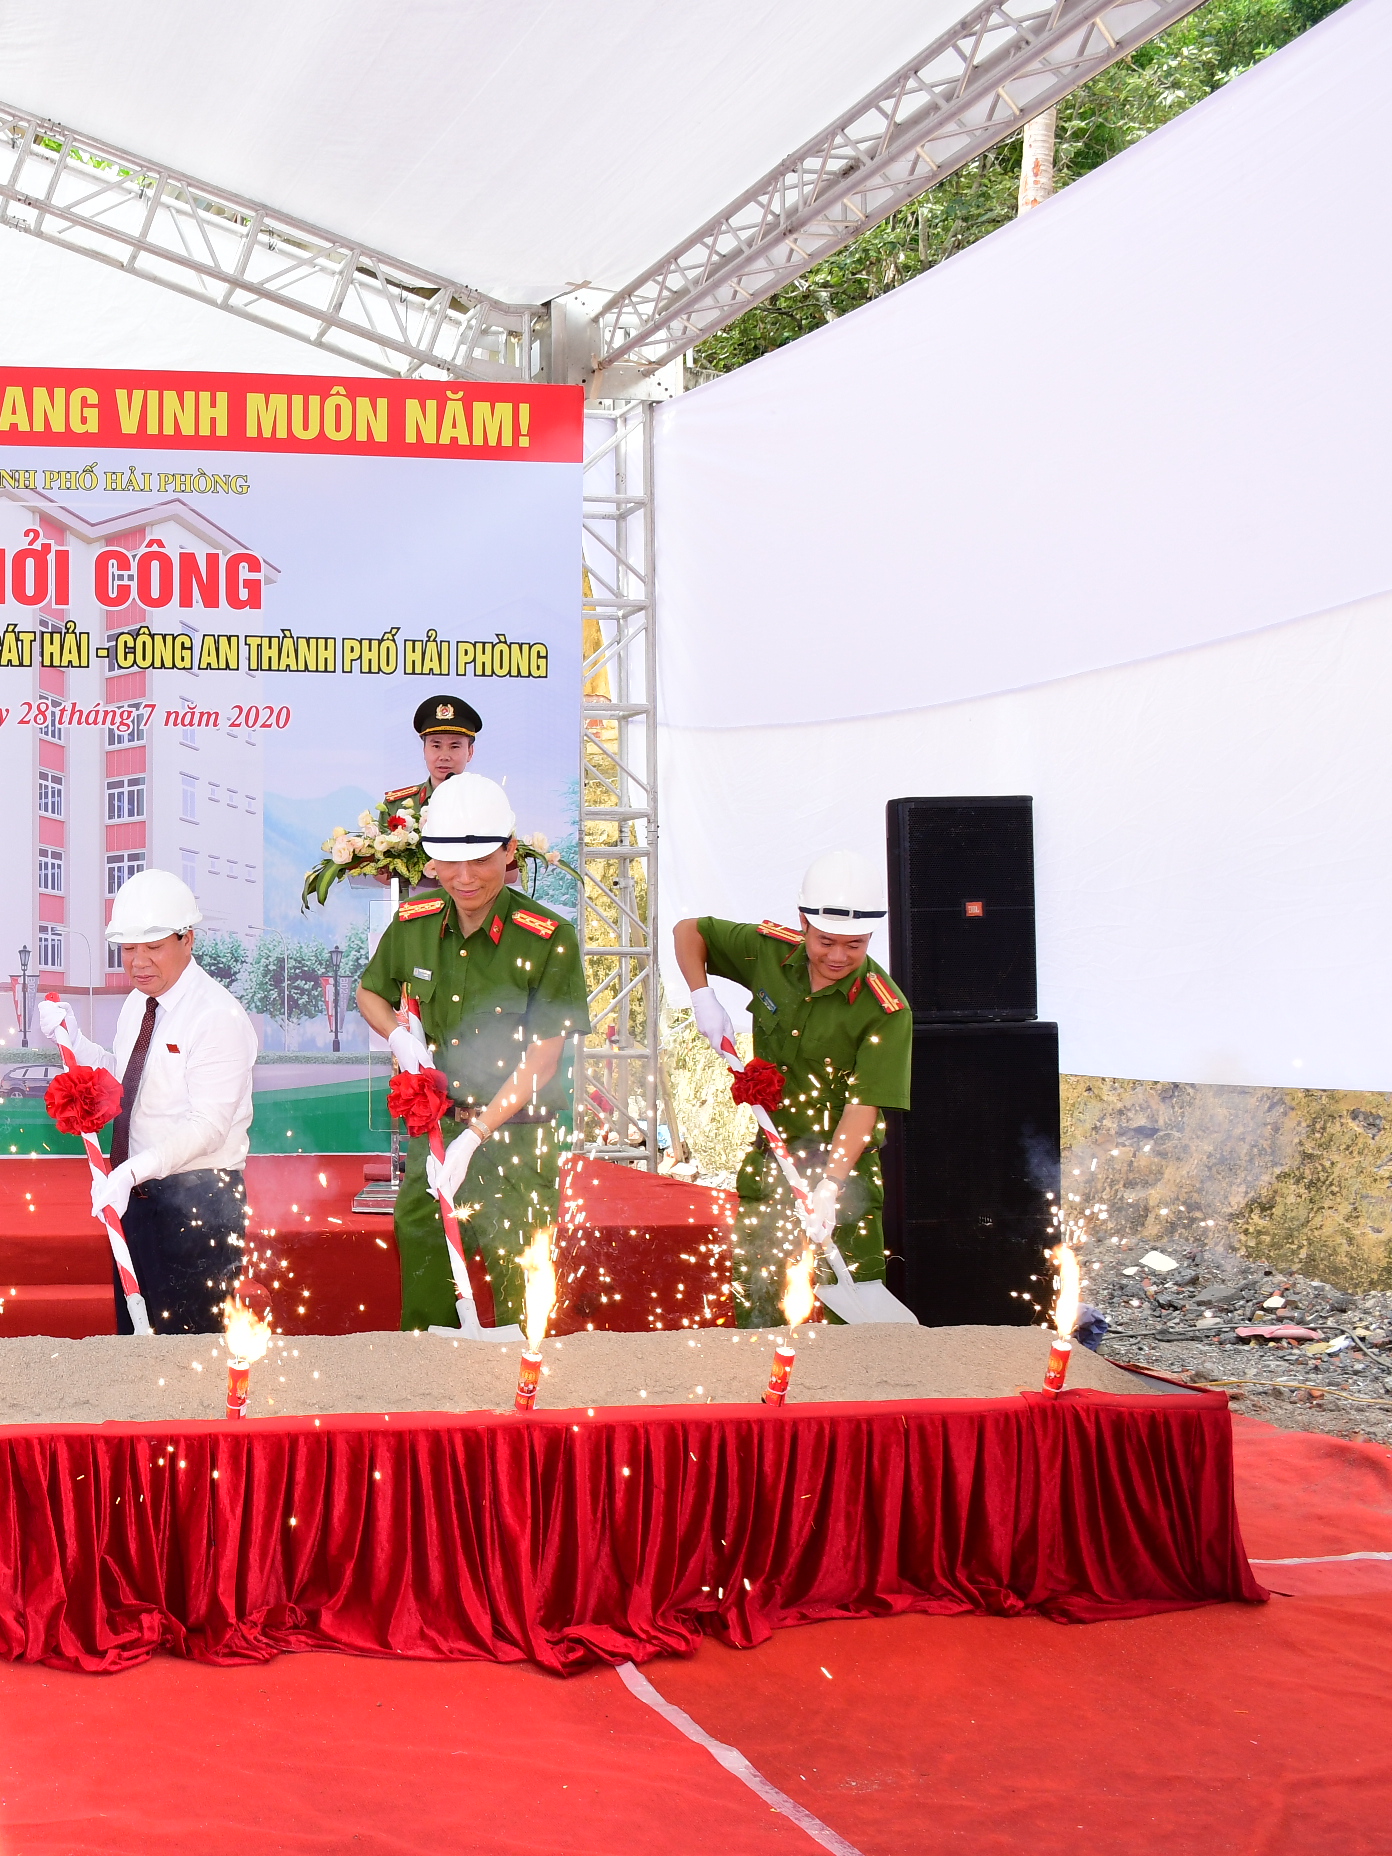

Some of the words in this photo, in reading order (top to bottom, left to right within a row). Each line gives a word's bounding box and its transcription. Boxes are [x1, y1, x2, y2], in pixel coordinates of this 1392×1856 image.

[117, 389, 229, 437] VINH
[247, 387, 390, 443] MUÔN
[406, 390, 531, 448] NĂM!
[43, 461, 98, 491] PHỐ
[103, 466, 151, 492] HẢI
[157, 467, 250, 494] PHÒNG
[95, 539, 263, 611] CÔNG
[41, 621, 90, 669] HẢI
[96, 647, 109, 658] -
[116, 627, 193, 670] CÔNG
[198, 634, 239, 671] AN
[245, 628, 335, 674] THÀNH
[342, 627, 399, 676] PHỐ
[404, 630, 450, 677] HẢI
[457, 635, 548, 679] PHÒNG
[18, 702, 49, 726] 28
[57, 702, 134, 733] tháng
[140, 703, 156, 727] 7
[164, 703, 221, 729] năm
[228, 705, 291, 729] 2020
